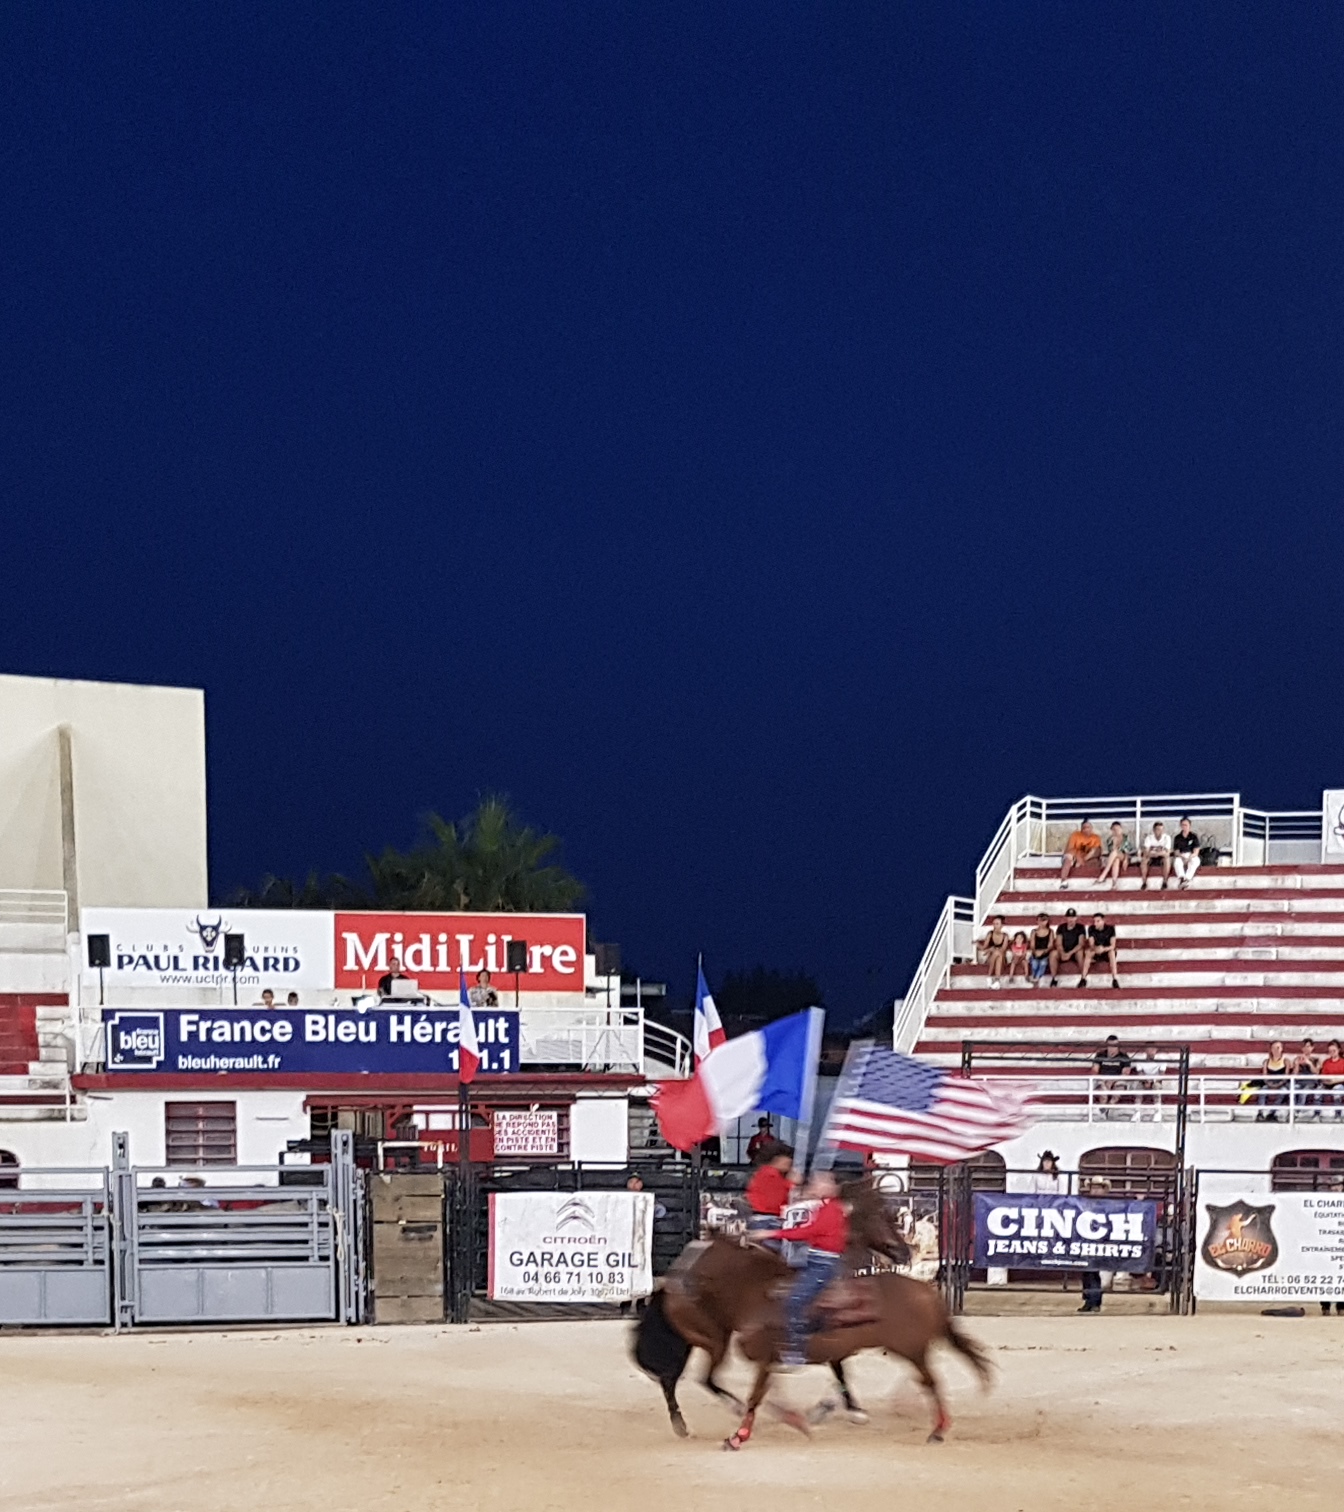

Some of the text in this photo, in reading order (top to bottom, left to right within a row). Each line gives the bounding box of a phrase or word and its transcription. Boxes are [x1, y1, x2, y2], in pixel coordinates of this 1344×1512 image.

[116, 944, 184, 953] CLUBS
[341, 932, 451, 972] Midi
[117, 954, 188, 971] PAUL
[179, 1014, 293, 1042] France
[305, 1014, 377, 1043] Bleu
[120, 1031, 160, 1050] bleu
[178, 1054, 281, 1070] bleuherault.fr
[448, 1050, 511, 1070] 11.1
[1303, 1200, 1314, 1208] EL
[987, 1206, 1144, 1242] CINCH
[987, 1239, 1143, 1258] JEANS & SHIRTS
[509, 1250, 639, 1269] GARAGE GIL
[522, 1271, 625, 1285] 04 66 71 10 83
[1287, 1275, 1301, 1284] 06
[1304, 1275, 1318, 1284] 52
[1320, 1275, 1334, 1284] 22
